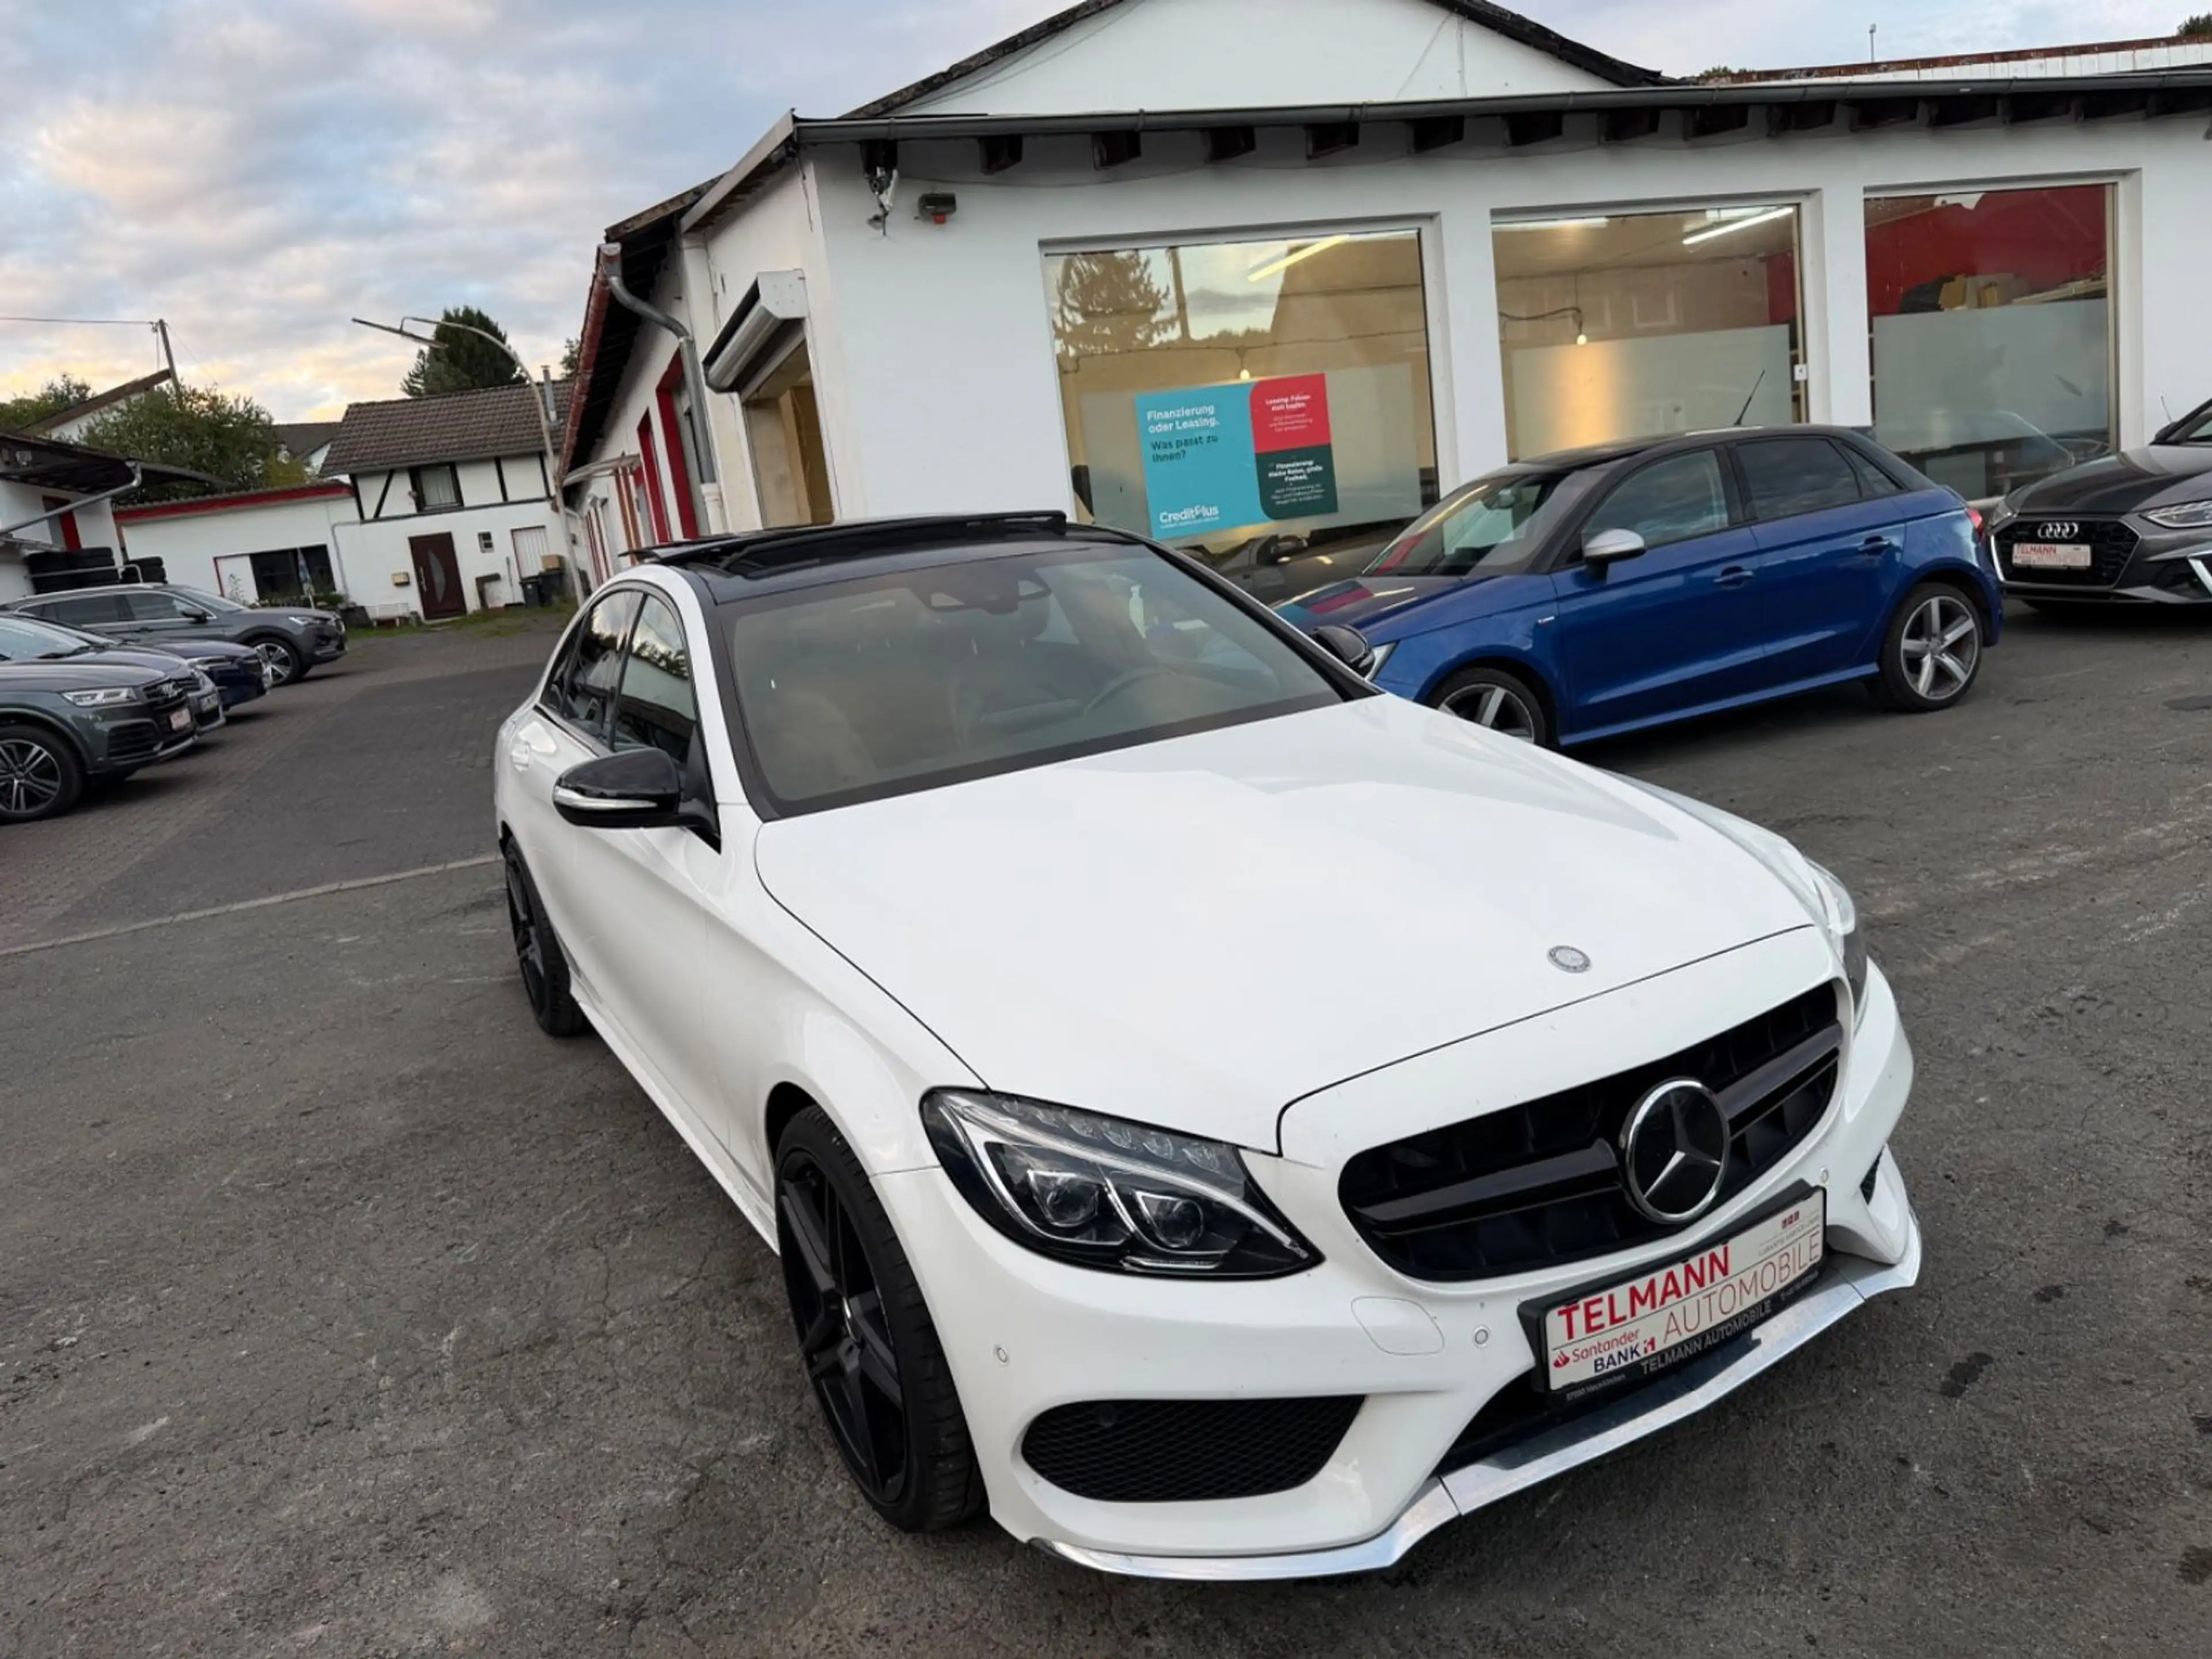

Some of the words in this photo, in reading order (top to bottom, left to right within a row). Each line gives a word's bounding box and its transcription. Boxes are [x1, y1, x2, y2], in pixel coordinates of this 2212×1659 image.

[1147, 404, 1215, 422] Finanzierung
[1147, 422, 1174, 434] oder
[1150, 440, 1173, 450] Was
[1175, 435, 1203, 449] passt
[1206, 435, 1219, 444] zu
[1152, 449, 1186, 464] Ihnen?
[1558, 1245, 1729, 1340] TELMANN
[1664, 1230, 1820, 1343] AUTOMOBILE
[1703, 1300, 1772, 1349] AUTOMOBILE
[1571, 1328, 1641, 1363] Santander
[1640, 1337, 1703, 1375] TELMANN
